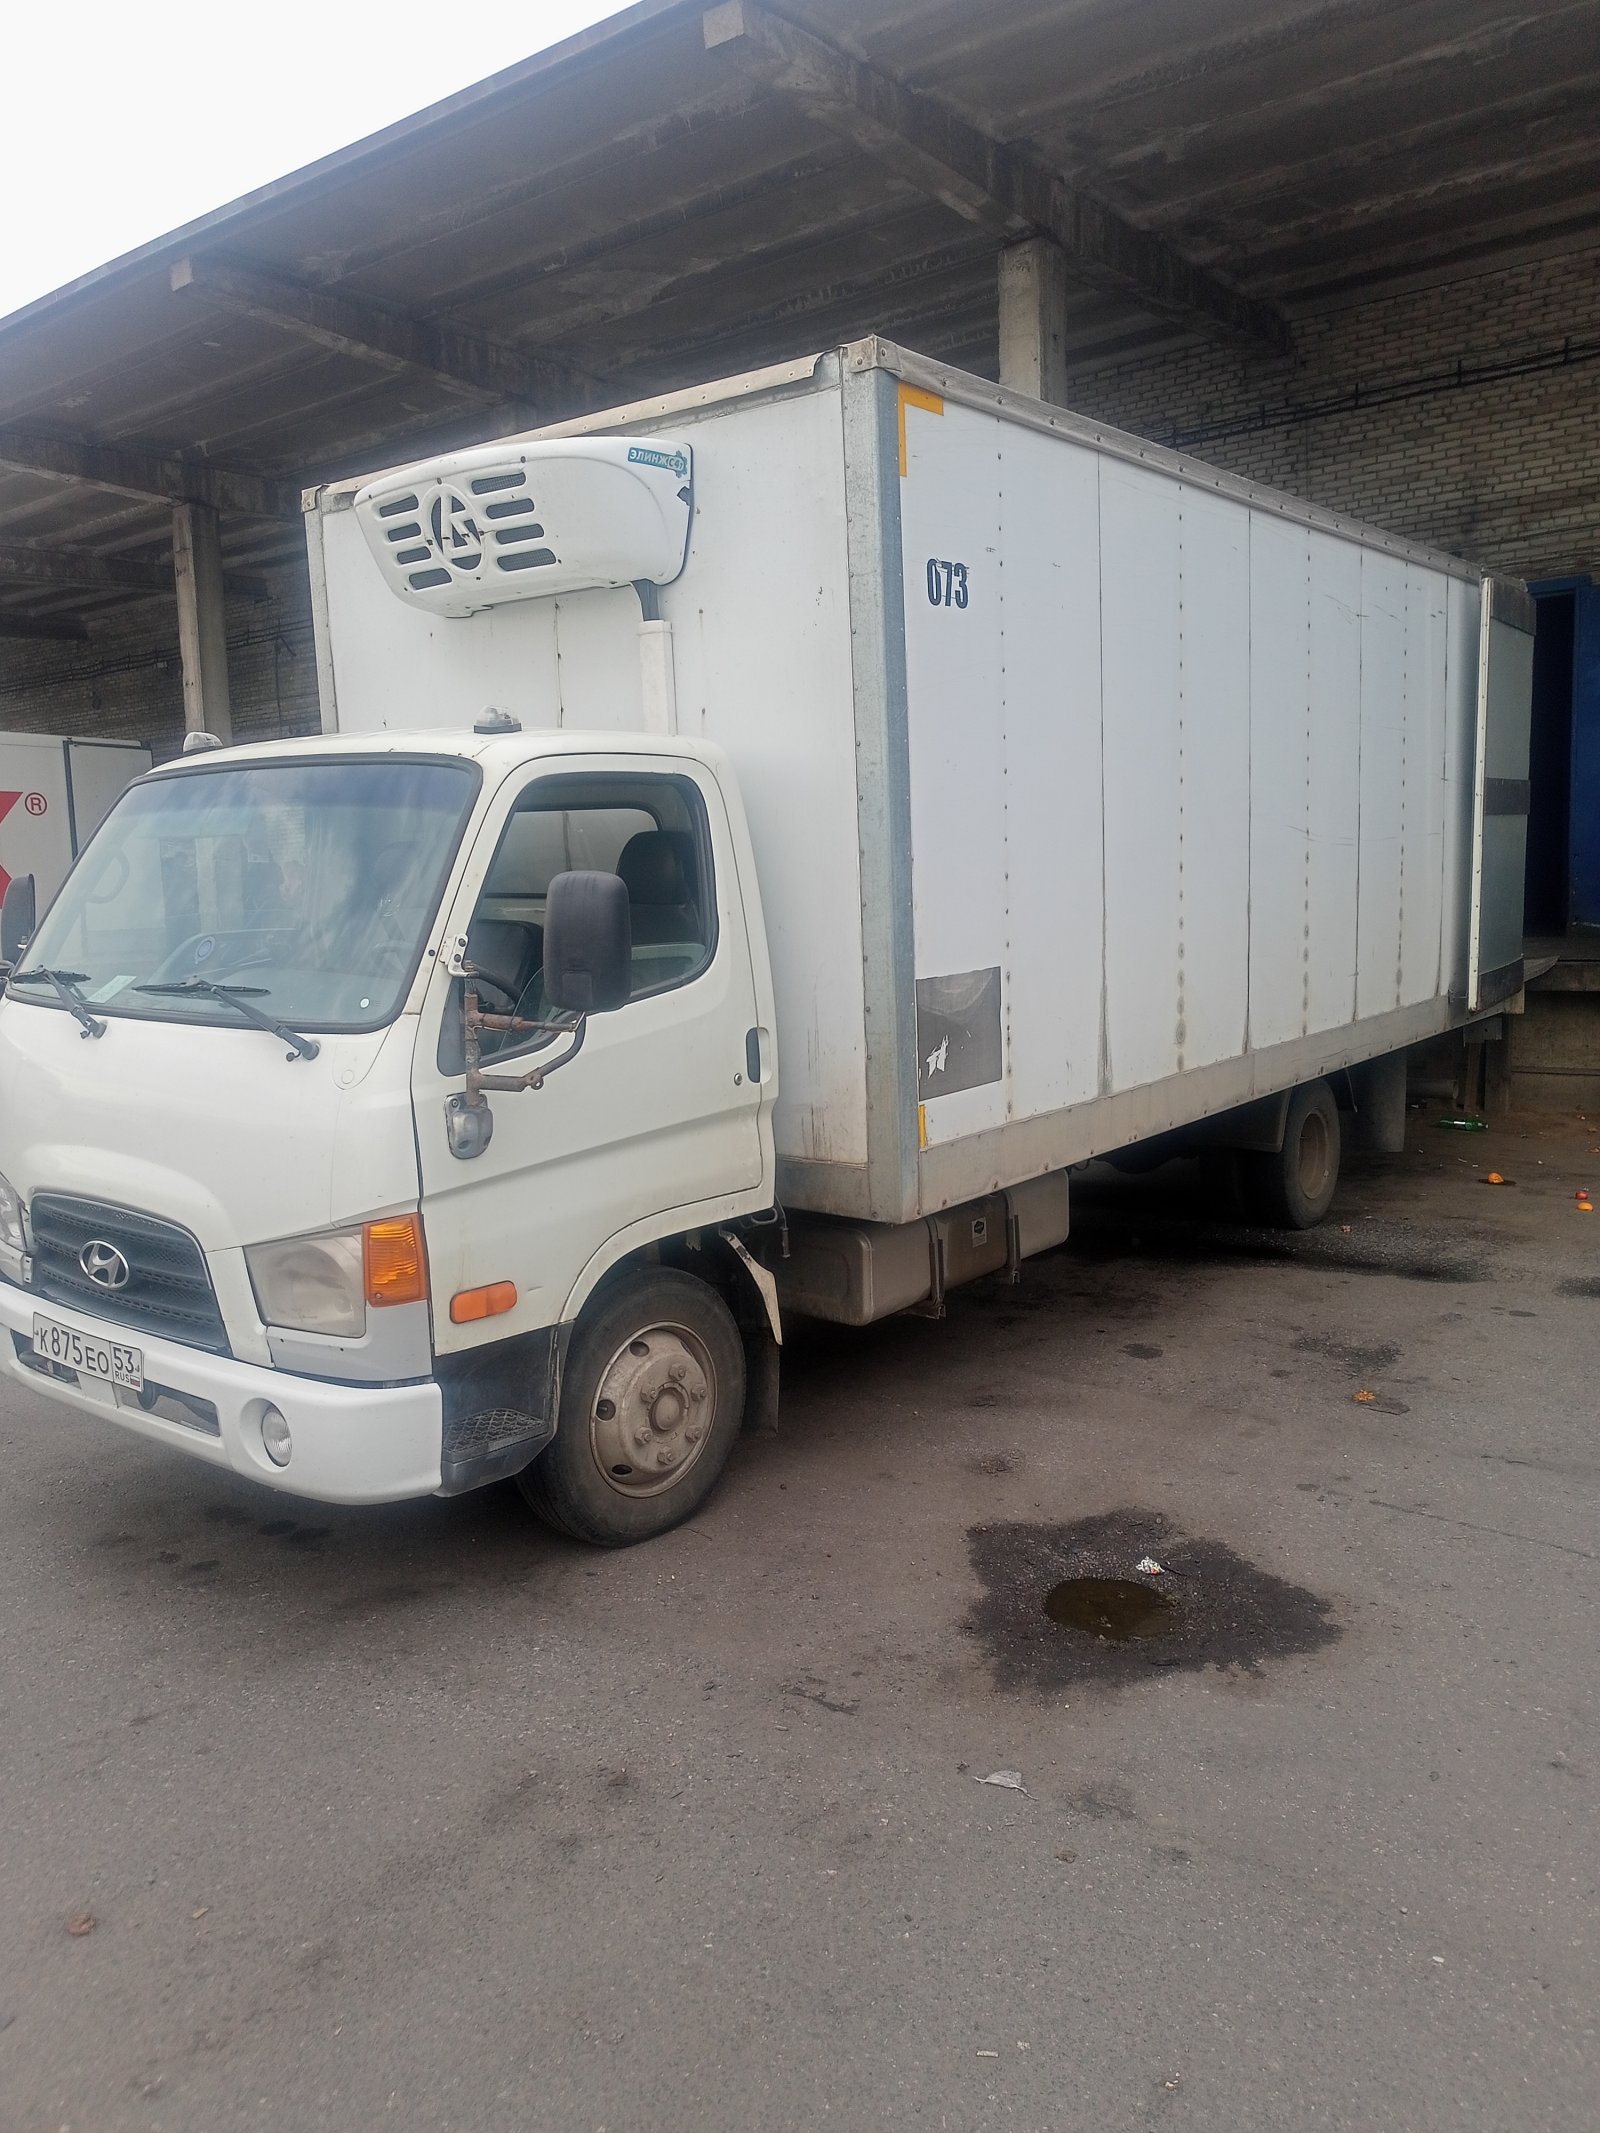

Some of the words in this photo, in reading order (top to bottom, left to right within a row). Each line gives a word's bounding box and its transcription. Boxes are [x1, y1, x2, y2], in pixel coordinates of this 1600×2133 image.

[927, 558, 969, 609] 073
[112, 1346, 134, 1373] 53
[114, 1370, 130, 1383] RUS
